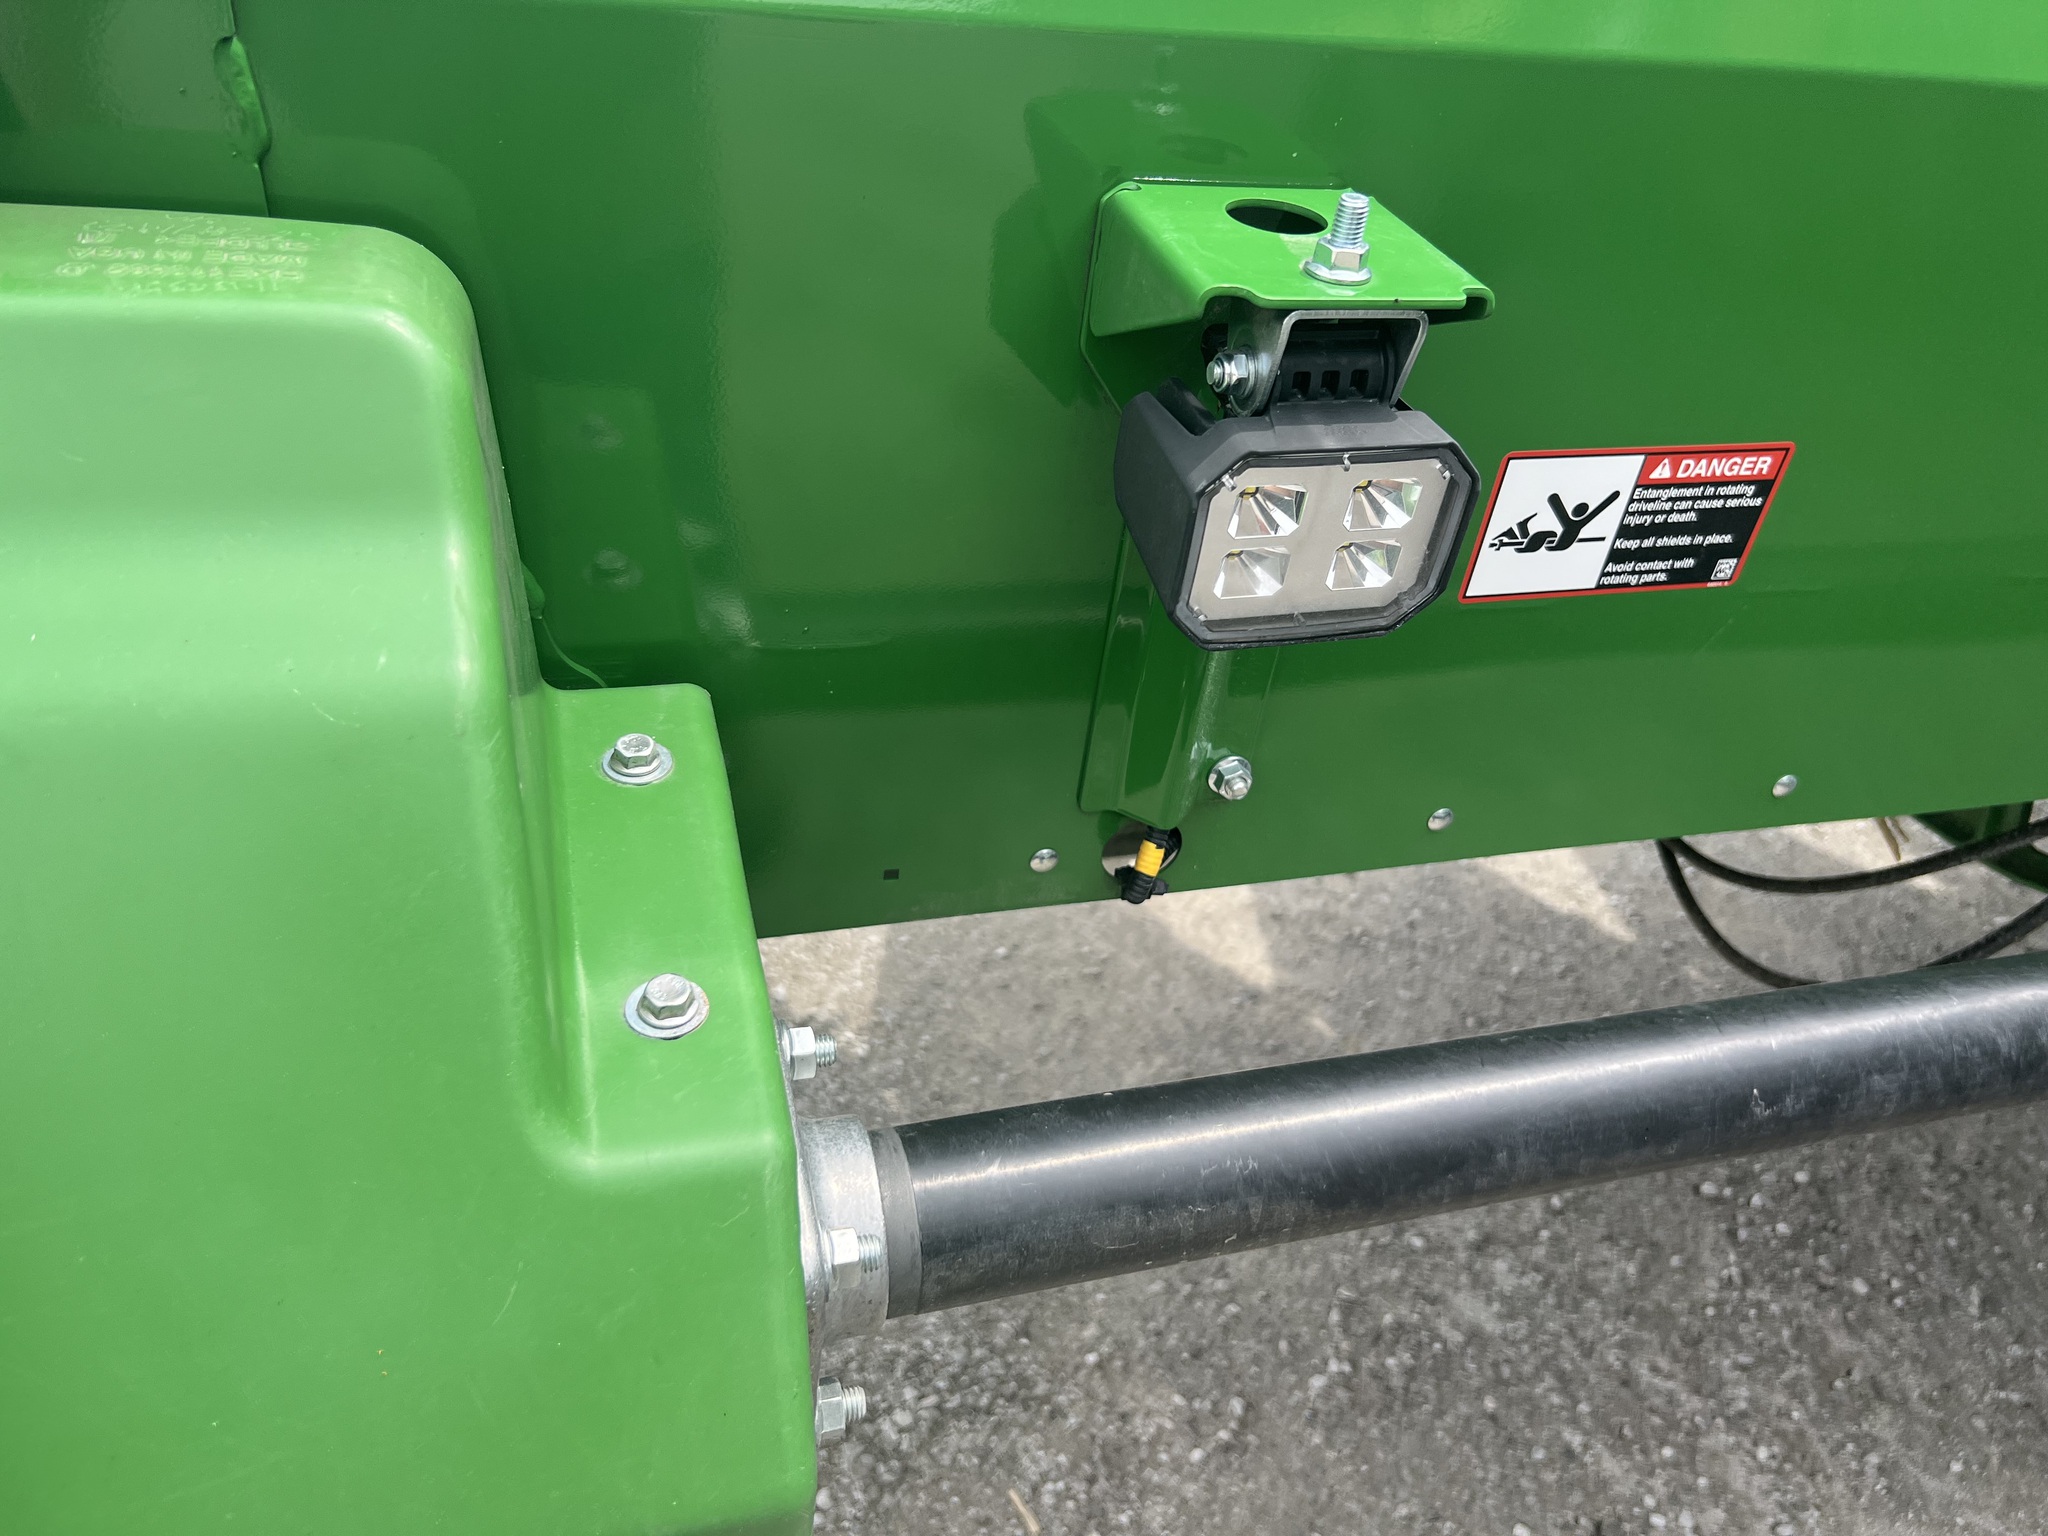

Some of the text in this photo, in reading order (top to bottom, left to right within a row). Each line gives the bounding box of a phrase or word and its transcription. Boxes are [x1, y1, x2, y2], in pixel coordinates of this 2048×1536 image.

[1676, 457, 1772, 478] DANGER
[1633, 484, 1755, 501] Entanglement in rotating
[1628, 496, 1763, 512] driveline can cause serious
[1623, 512, 1698, 527] injury or death.
[1614, 534, 1733, 551] Keep all shields in place.
[1604, 558, 1695, 573] Avoid contact with
[1600, 572, 1668, 585] rotating parts.
